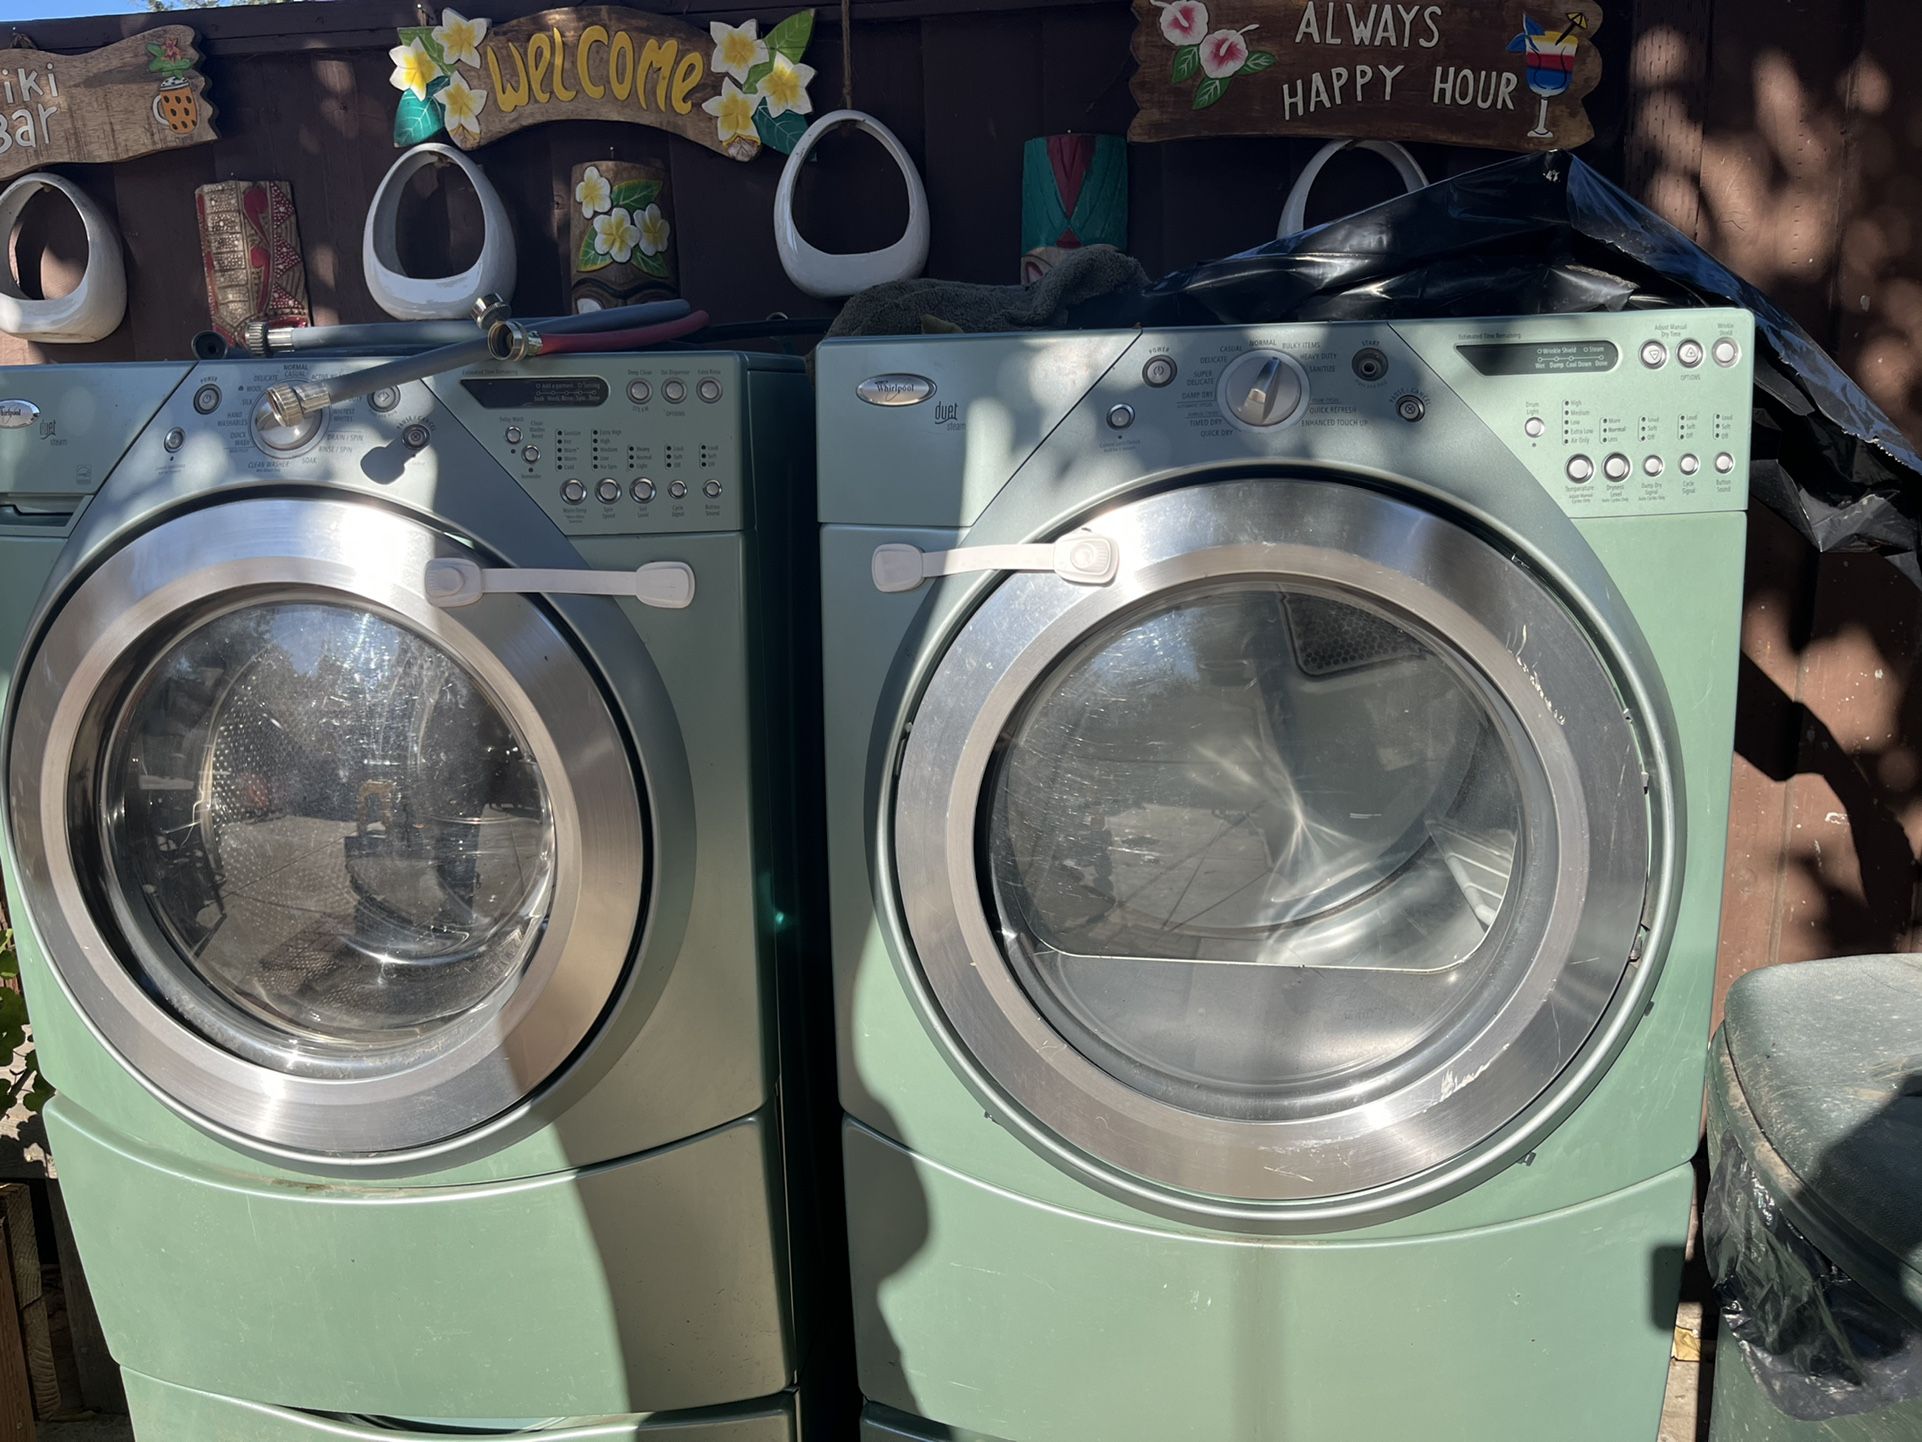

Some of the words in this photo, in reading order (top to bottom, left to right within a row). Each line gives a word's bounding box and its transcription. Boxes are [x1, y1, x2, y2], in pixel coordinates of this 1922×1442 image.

[1295, 1, 1442, 48] ALWAYS
[1283, 65, 1404, 121] HAPPY
[1433, 66, 1518, 111] HOUR
[1248, 339, 1277, 348] NORMAL
[874, 380, 915, 398] Whirlpool
[935, 401, 959, 424] duet
